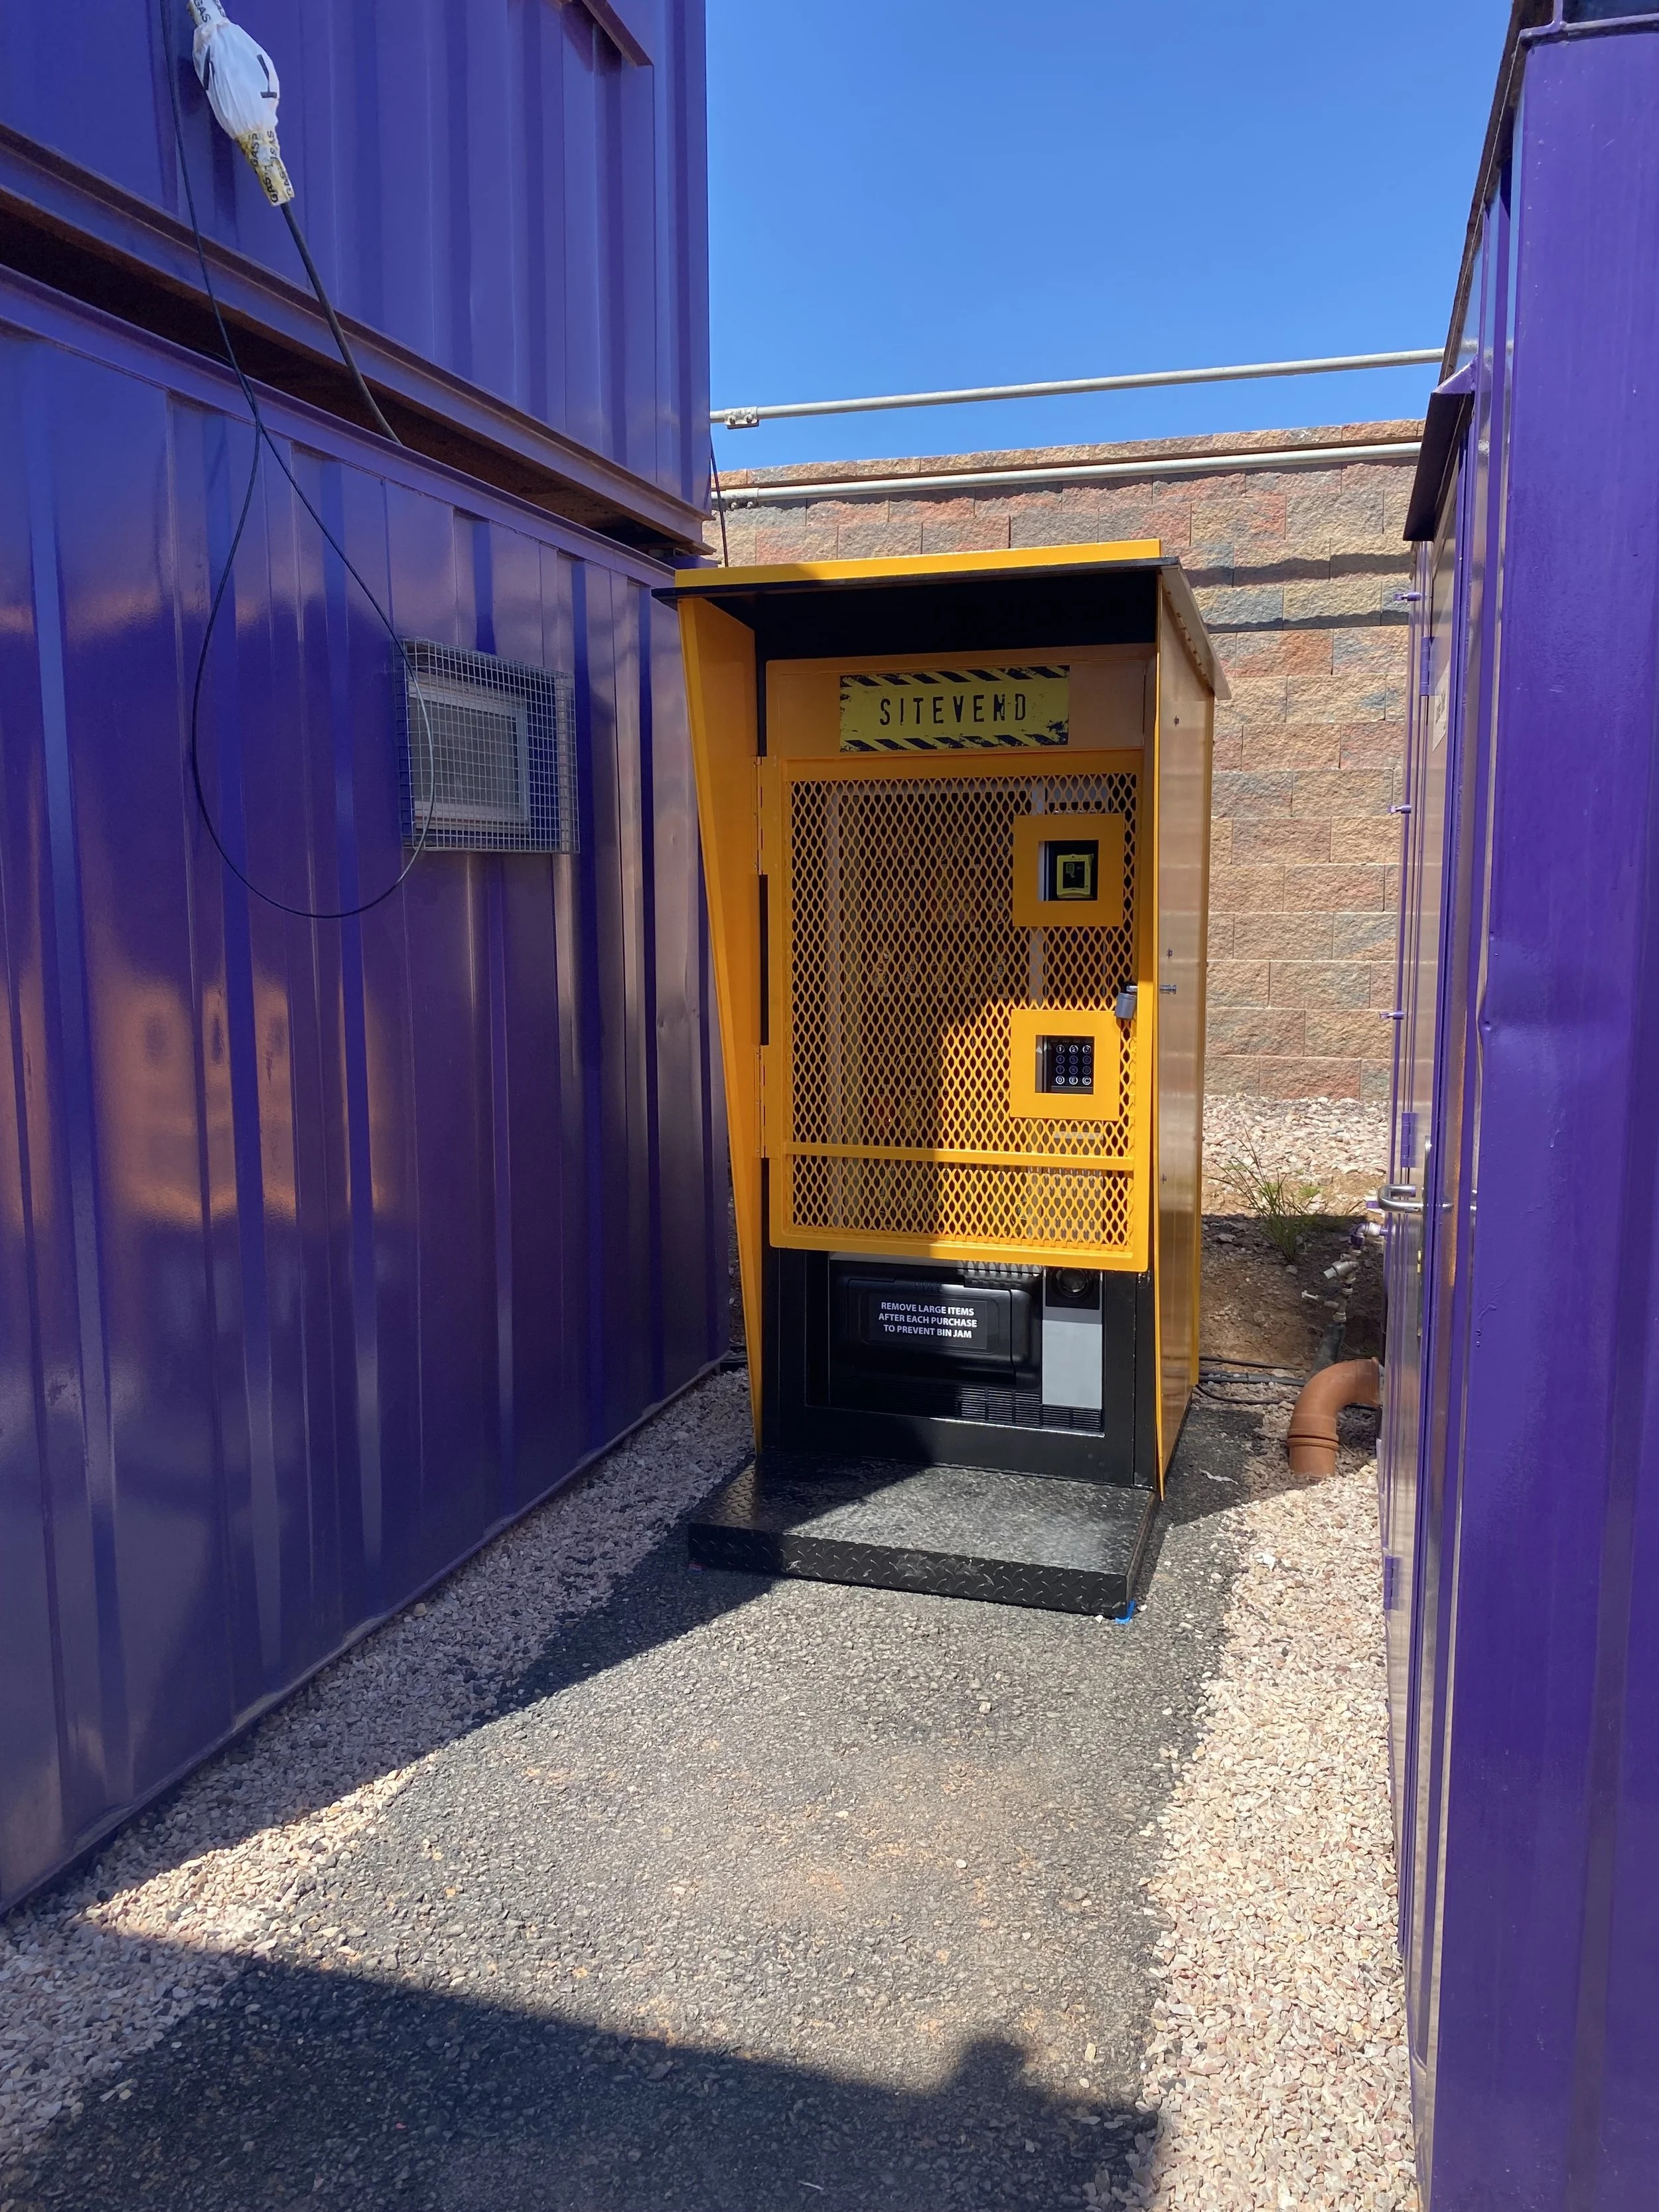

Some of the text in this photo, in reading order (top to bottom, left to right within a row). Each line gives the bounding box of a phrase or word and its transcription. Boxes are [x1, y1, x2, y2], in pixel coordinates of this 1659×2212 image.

[879, 693, 1027, 726] SITEVEND
[881, 1301, 974, 1316] REMOVE LARGE ITEMS
[879, 1313, 977, 1327] AFTER EACH PURCHASE
[897, 1325, 935, 1335] PREVENT
[936, 1328, 952, 1337] BIN
[953, 1329, 972, 1339] JAM
